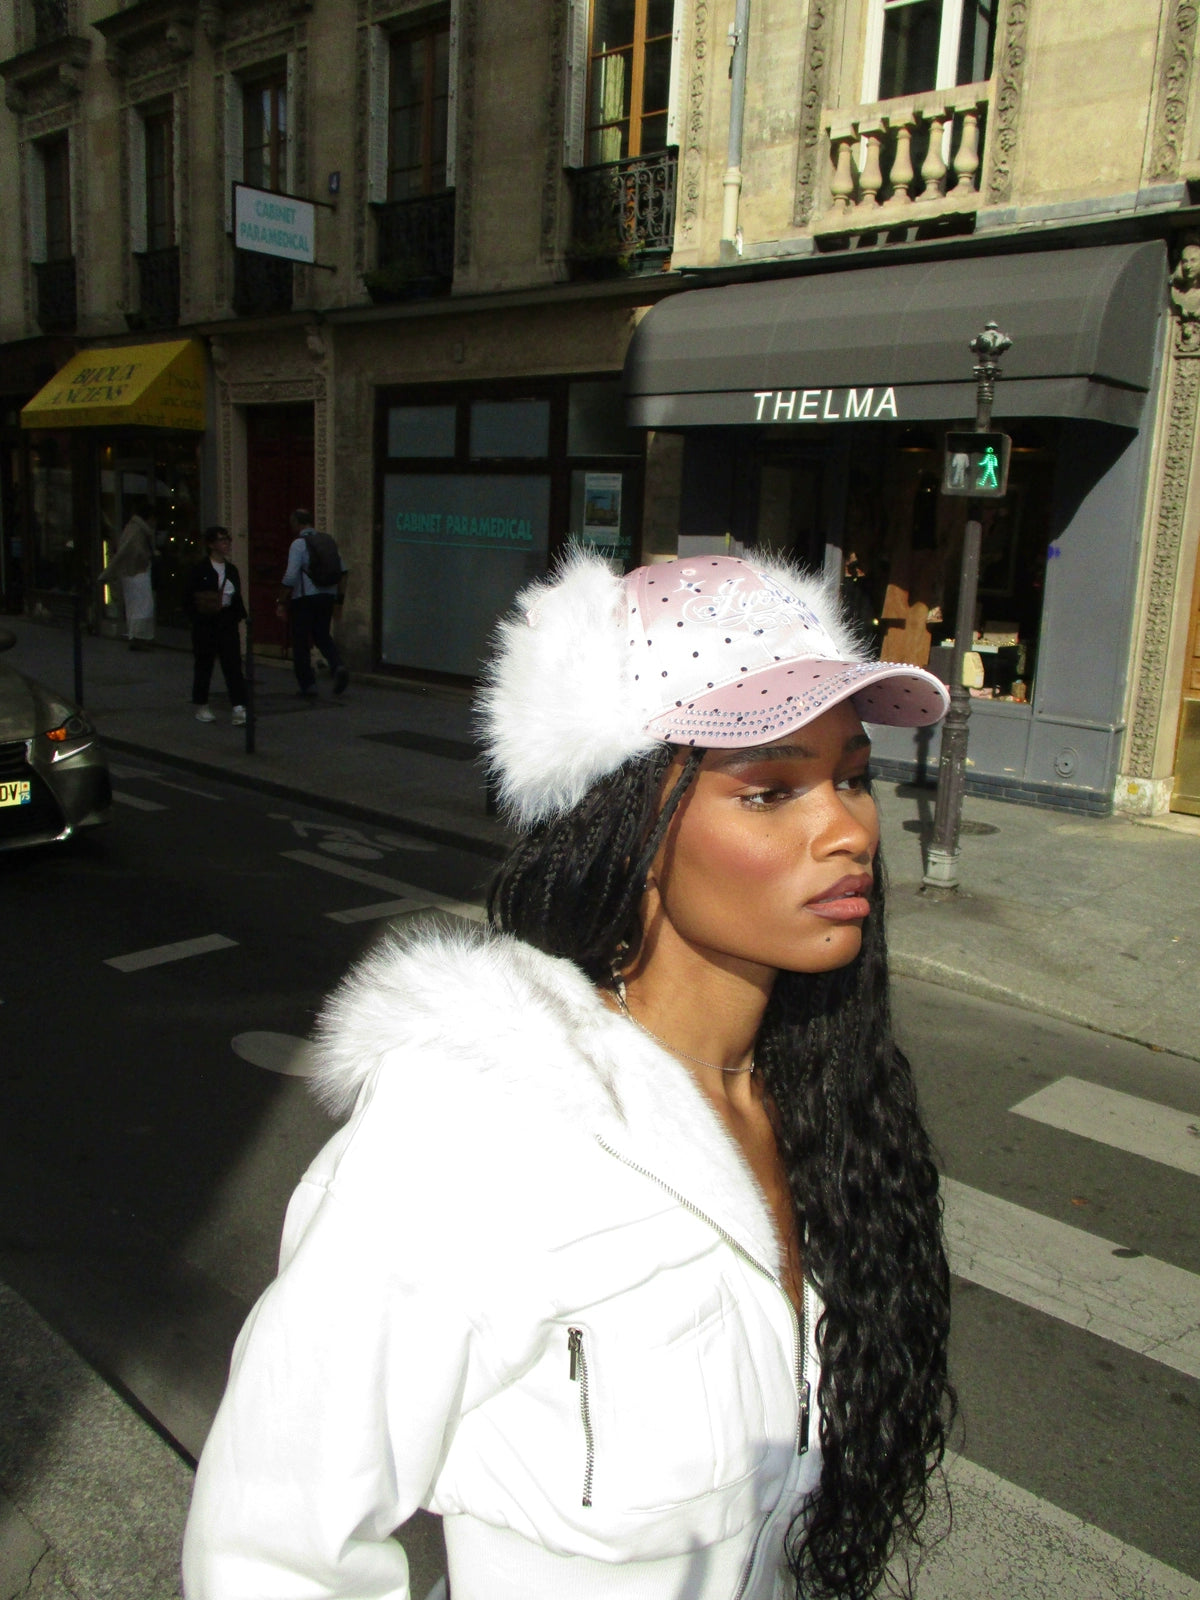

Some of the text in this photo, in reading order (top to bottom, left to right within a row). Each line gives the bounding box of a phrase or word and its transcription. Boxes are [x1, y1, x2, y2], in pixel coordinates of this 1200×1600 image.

[255, 199, 296, 225] CABINET
[754, 387, 898, 420] THELMA
[396, 512, 533, 541] CABINET PARAMEDICAL
[21, 792, 31, 801] 75
